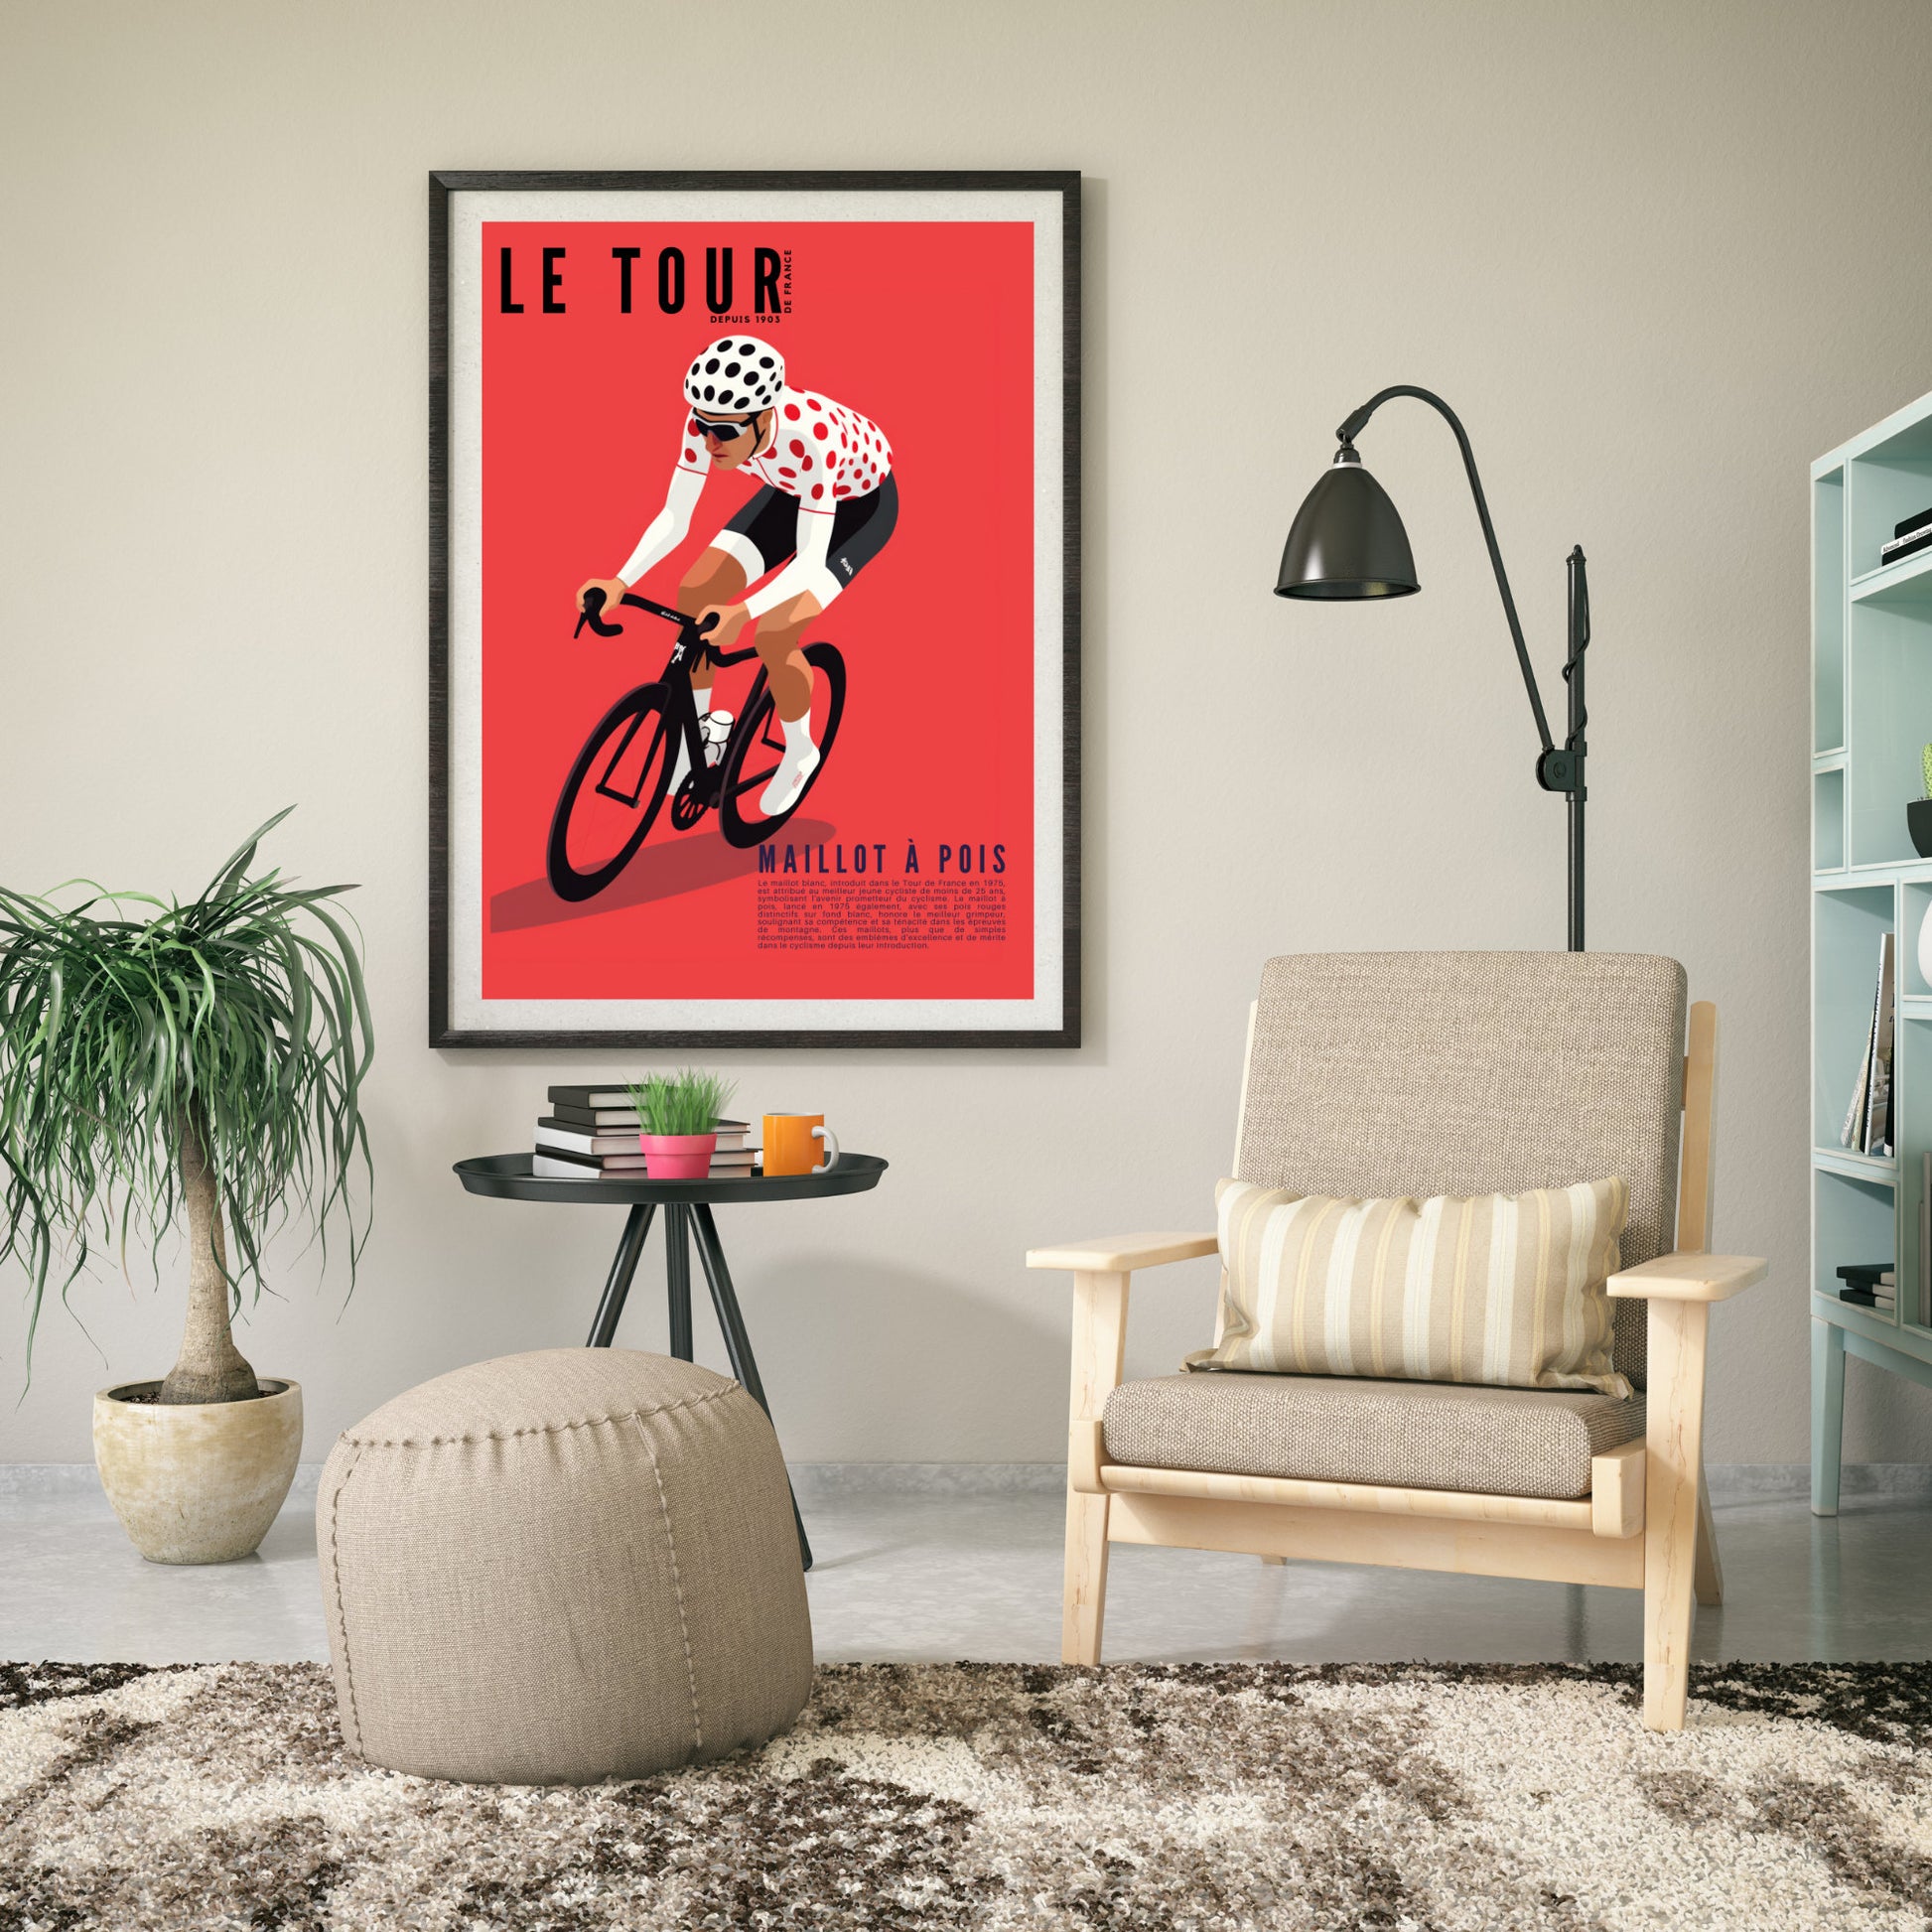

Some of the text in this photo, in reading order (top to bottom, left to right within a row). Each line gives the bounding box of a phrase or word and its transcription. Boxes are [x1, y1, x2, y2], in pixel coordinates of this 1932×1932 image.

[500, 246, 782, 315] LE TOUR
[783, 249, 792, 314] DE FRANCE
[759, 839, 1006, 874] MAILLOT À POIS
